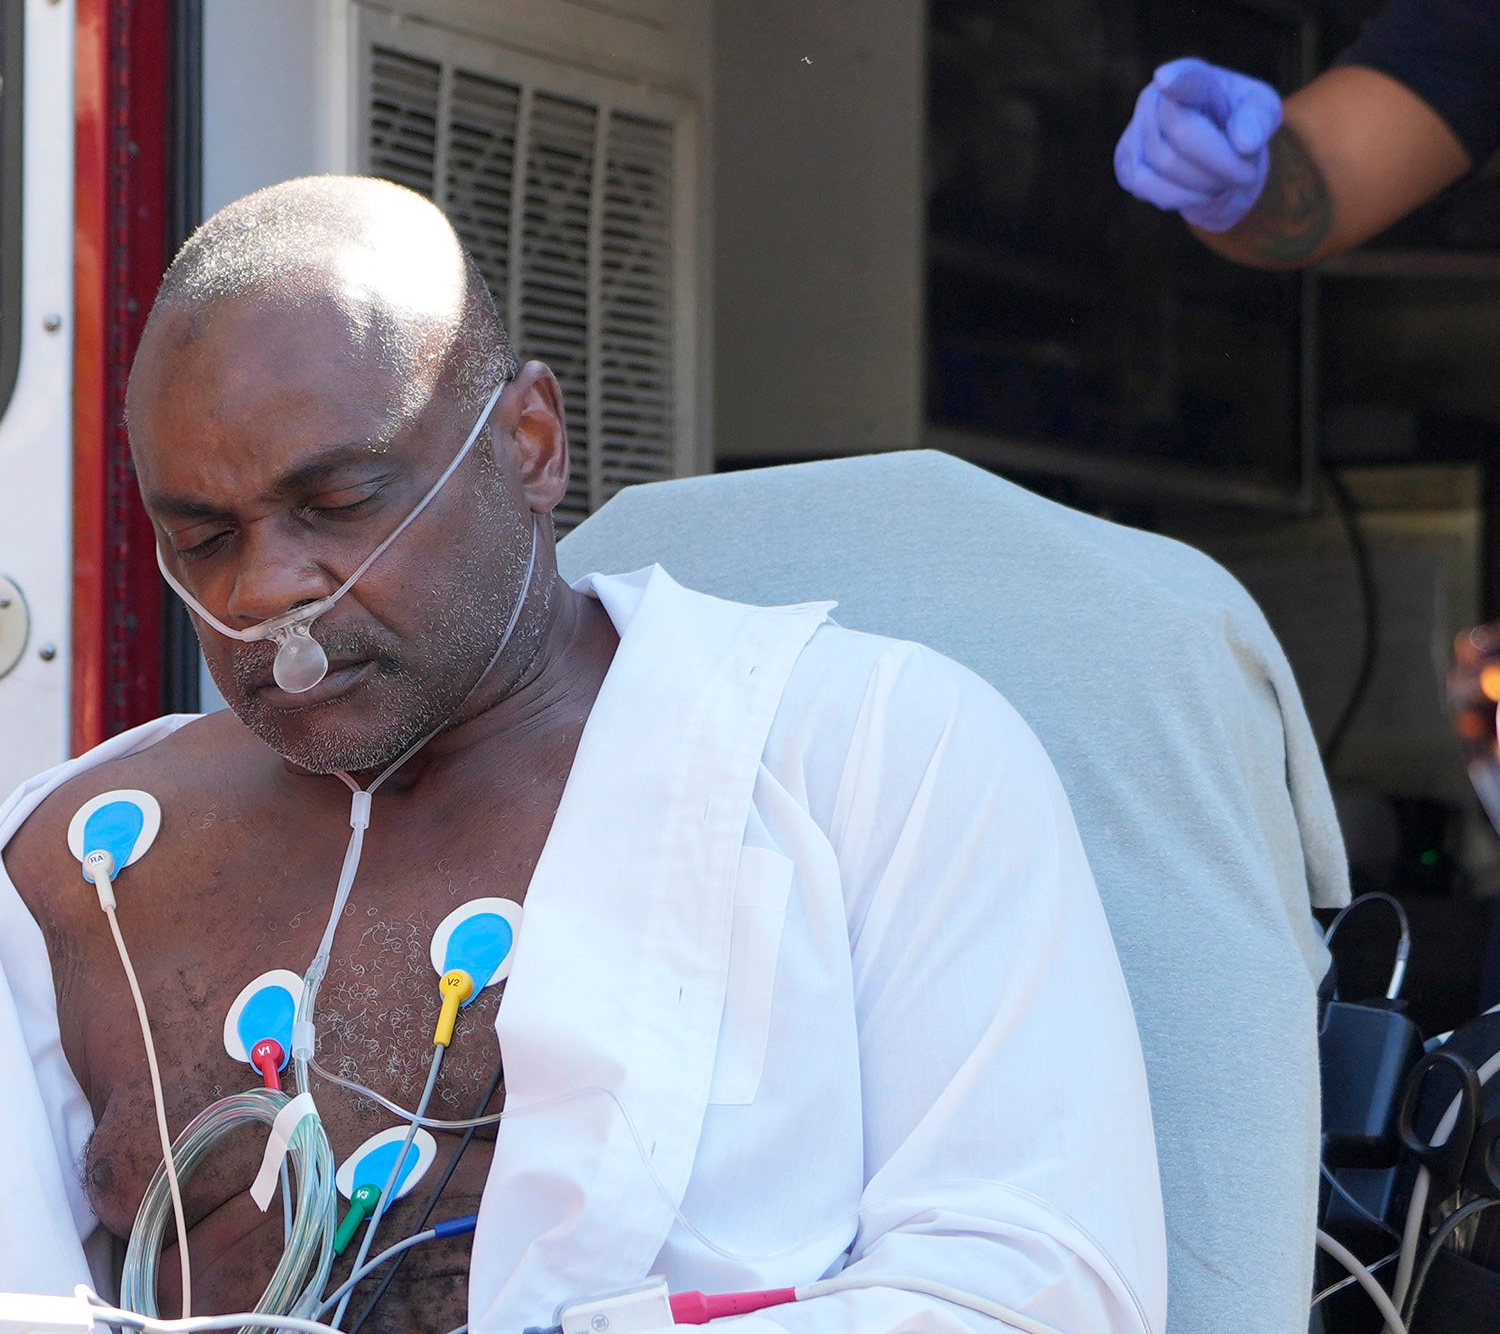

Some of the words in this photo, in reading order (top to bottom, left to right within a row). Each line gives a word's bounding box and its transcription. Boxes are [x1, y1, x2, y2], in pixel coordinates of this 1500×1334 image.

[90, 854, 104, 864] RA
[447, 977, 460, 987] V2
[257, 1045, 271, 1056] V1
[356, 1189, 369, 1200] V3
